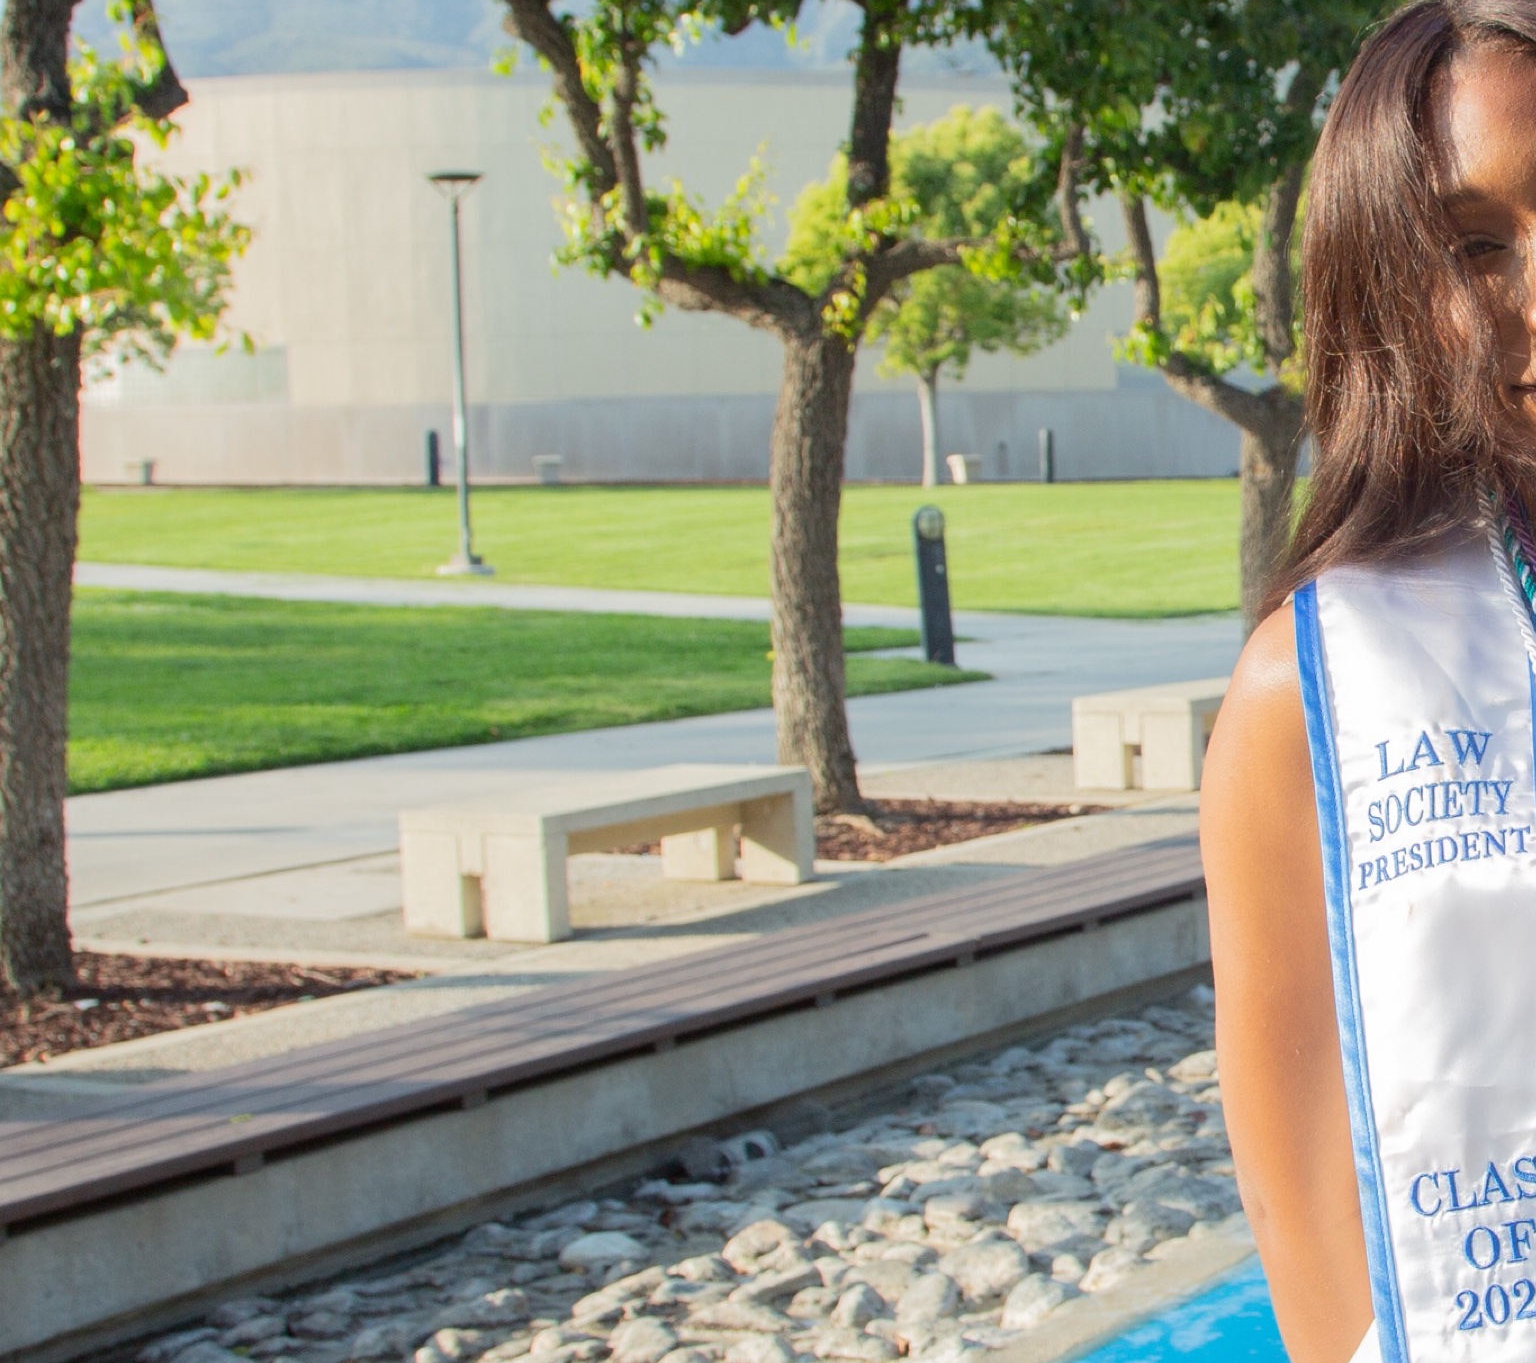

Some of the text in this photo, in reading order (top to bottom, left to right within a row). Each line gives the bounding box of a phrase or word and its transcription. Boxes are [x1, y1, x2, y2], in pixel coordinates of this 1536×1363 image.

[1375, 729, 1493, 782] LAW
[1368, 780, 1514, 843] SOCIETY
[1358, 826, 1531, 890] PRESIDENT
